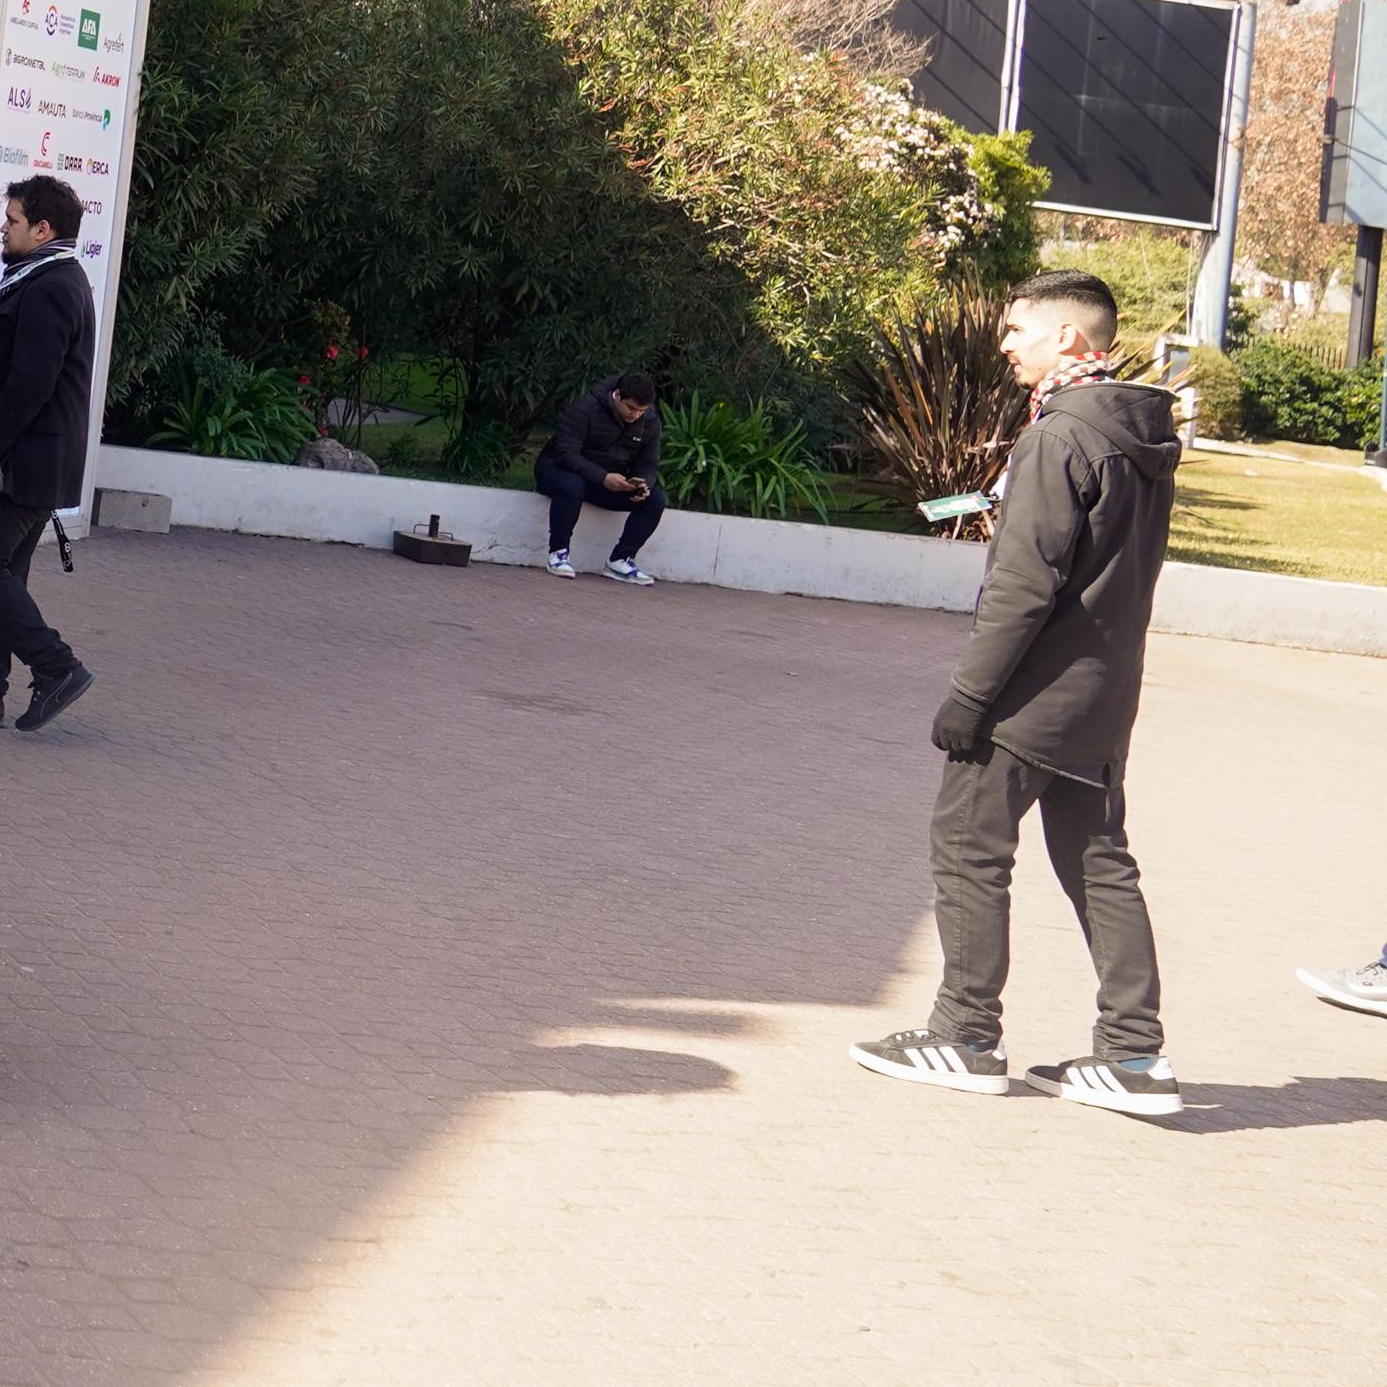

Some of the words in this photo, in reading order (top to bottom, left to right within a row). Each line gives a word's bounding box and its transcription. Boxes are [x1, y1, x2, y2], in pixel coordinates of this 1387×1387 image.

[7, 87, 26, 108] ALS
[38, 100, 66, 118] AMAUTA
[4, 146, 28, 167] Biofilm
[81, 200, 102, 214] ACTO
[85, 240, 102, 258] Ligier
